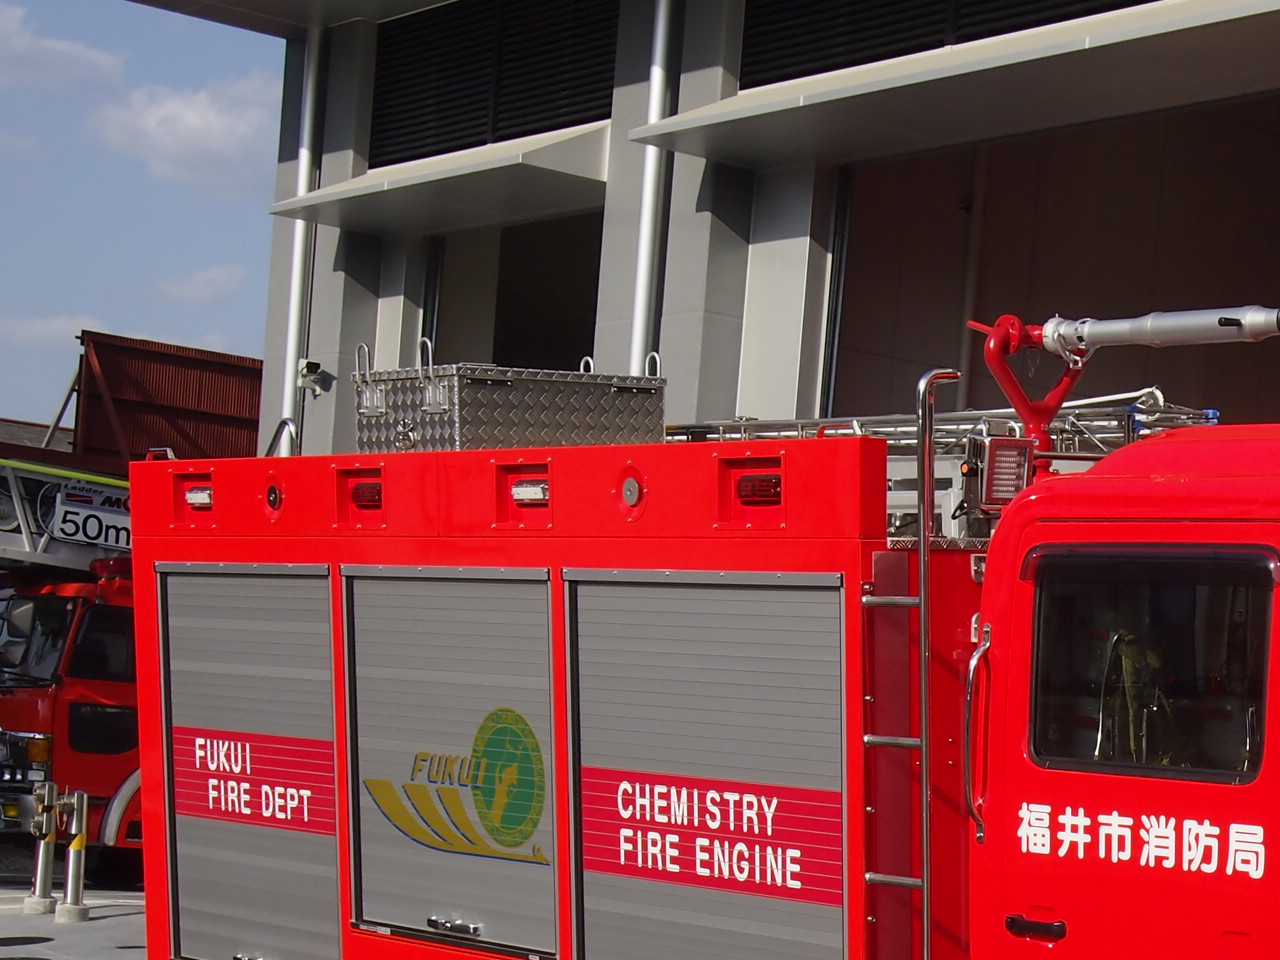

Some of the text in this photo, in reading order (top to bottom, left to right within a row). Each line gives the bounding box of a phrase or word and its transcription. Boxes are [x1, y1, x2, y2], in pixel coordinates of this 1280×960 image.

[63, 483, 105, 495] Ladder
[60, 510, 131, 547] 50m
[195, 737, 251, 775] FUKUI
[410, 751, 487, 789] FUKUI
[208, 778, 312, 822] FIRE DEPT
[617, 781, 778, 836] CHEMISTRY
[619, 828, 802, 889] FIRE ENGINE
[1017, 802, 1266, 880] 福井市消防局
